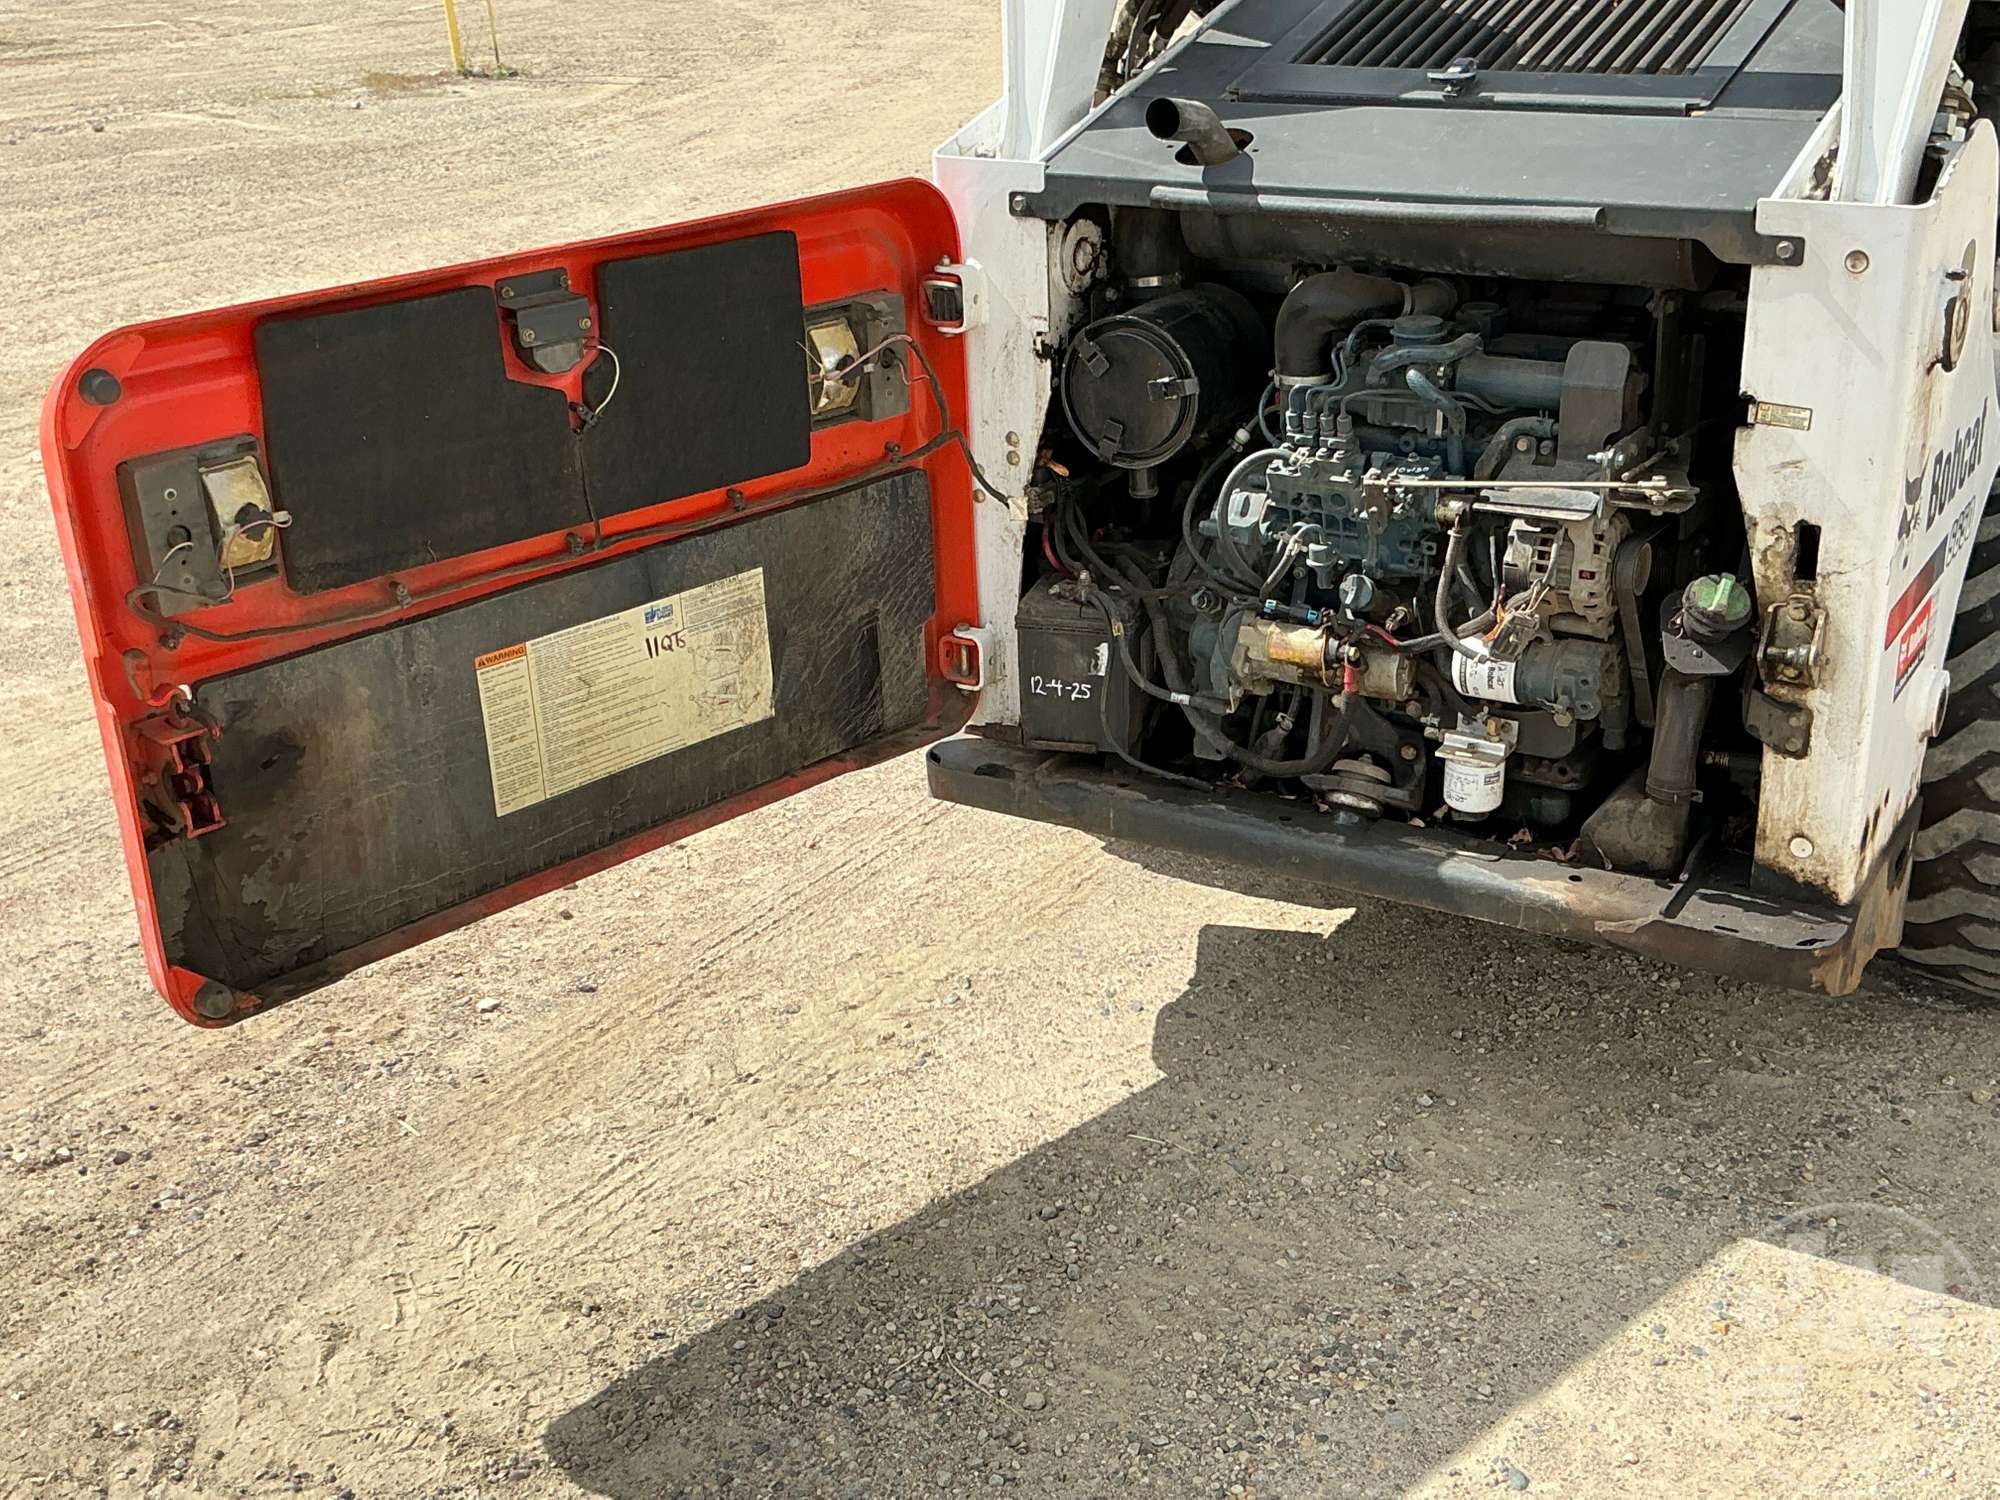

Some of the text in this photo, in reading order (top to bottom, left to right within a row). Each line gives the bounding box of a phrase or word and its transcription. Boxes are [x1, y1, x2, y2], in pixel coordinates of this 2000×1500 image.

[1926, 396, 1988, 532] Bobcat
[485, 646, 525, 664] WARNING
[1031, 675, 1092, 701] 12-4-25
[1487, 666, 1497, 690] Bobcat
